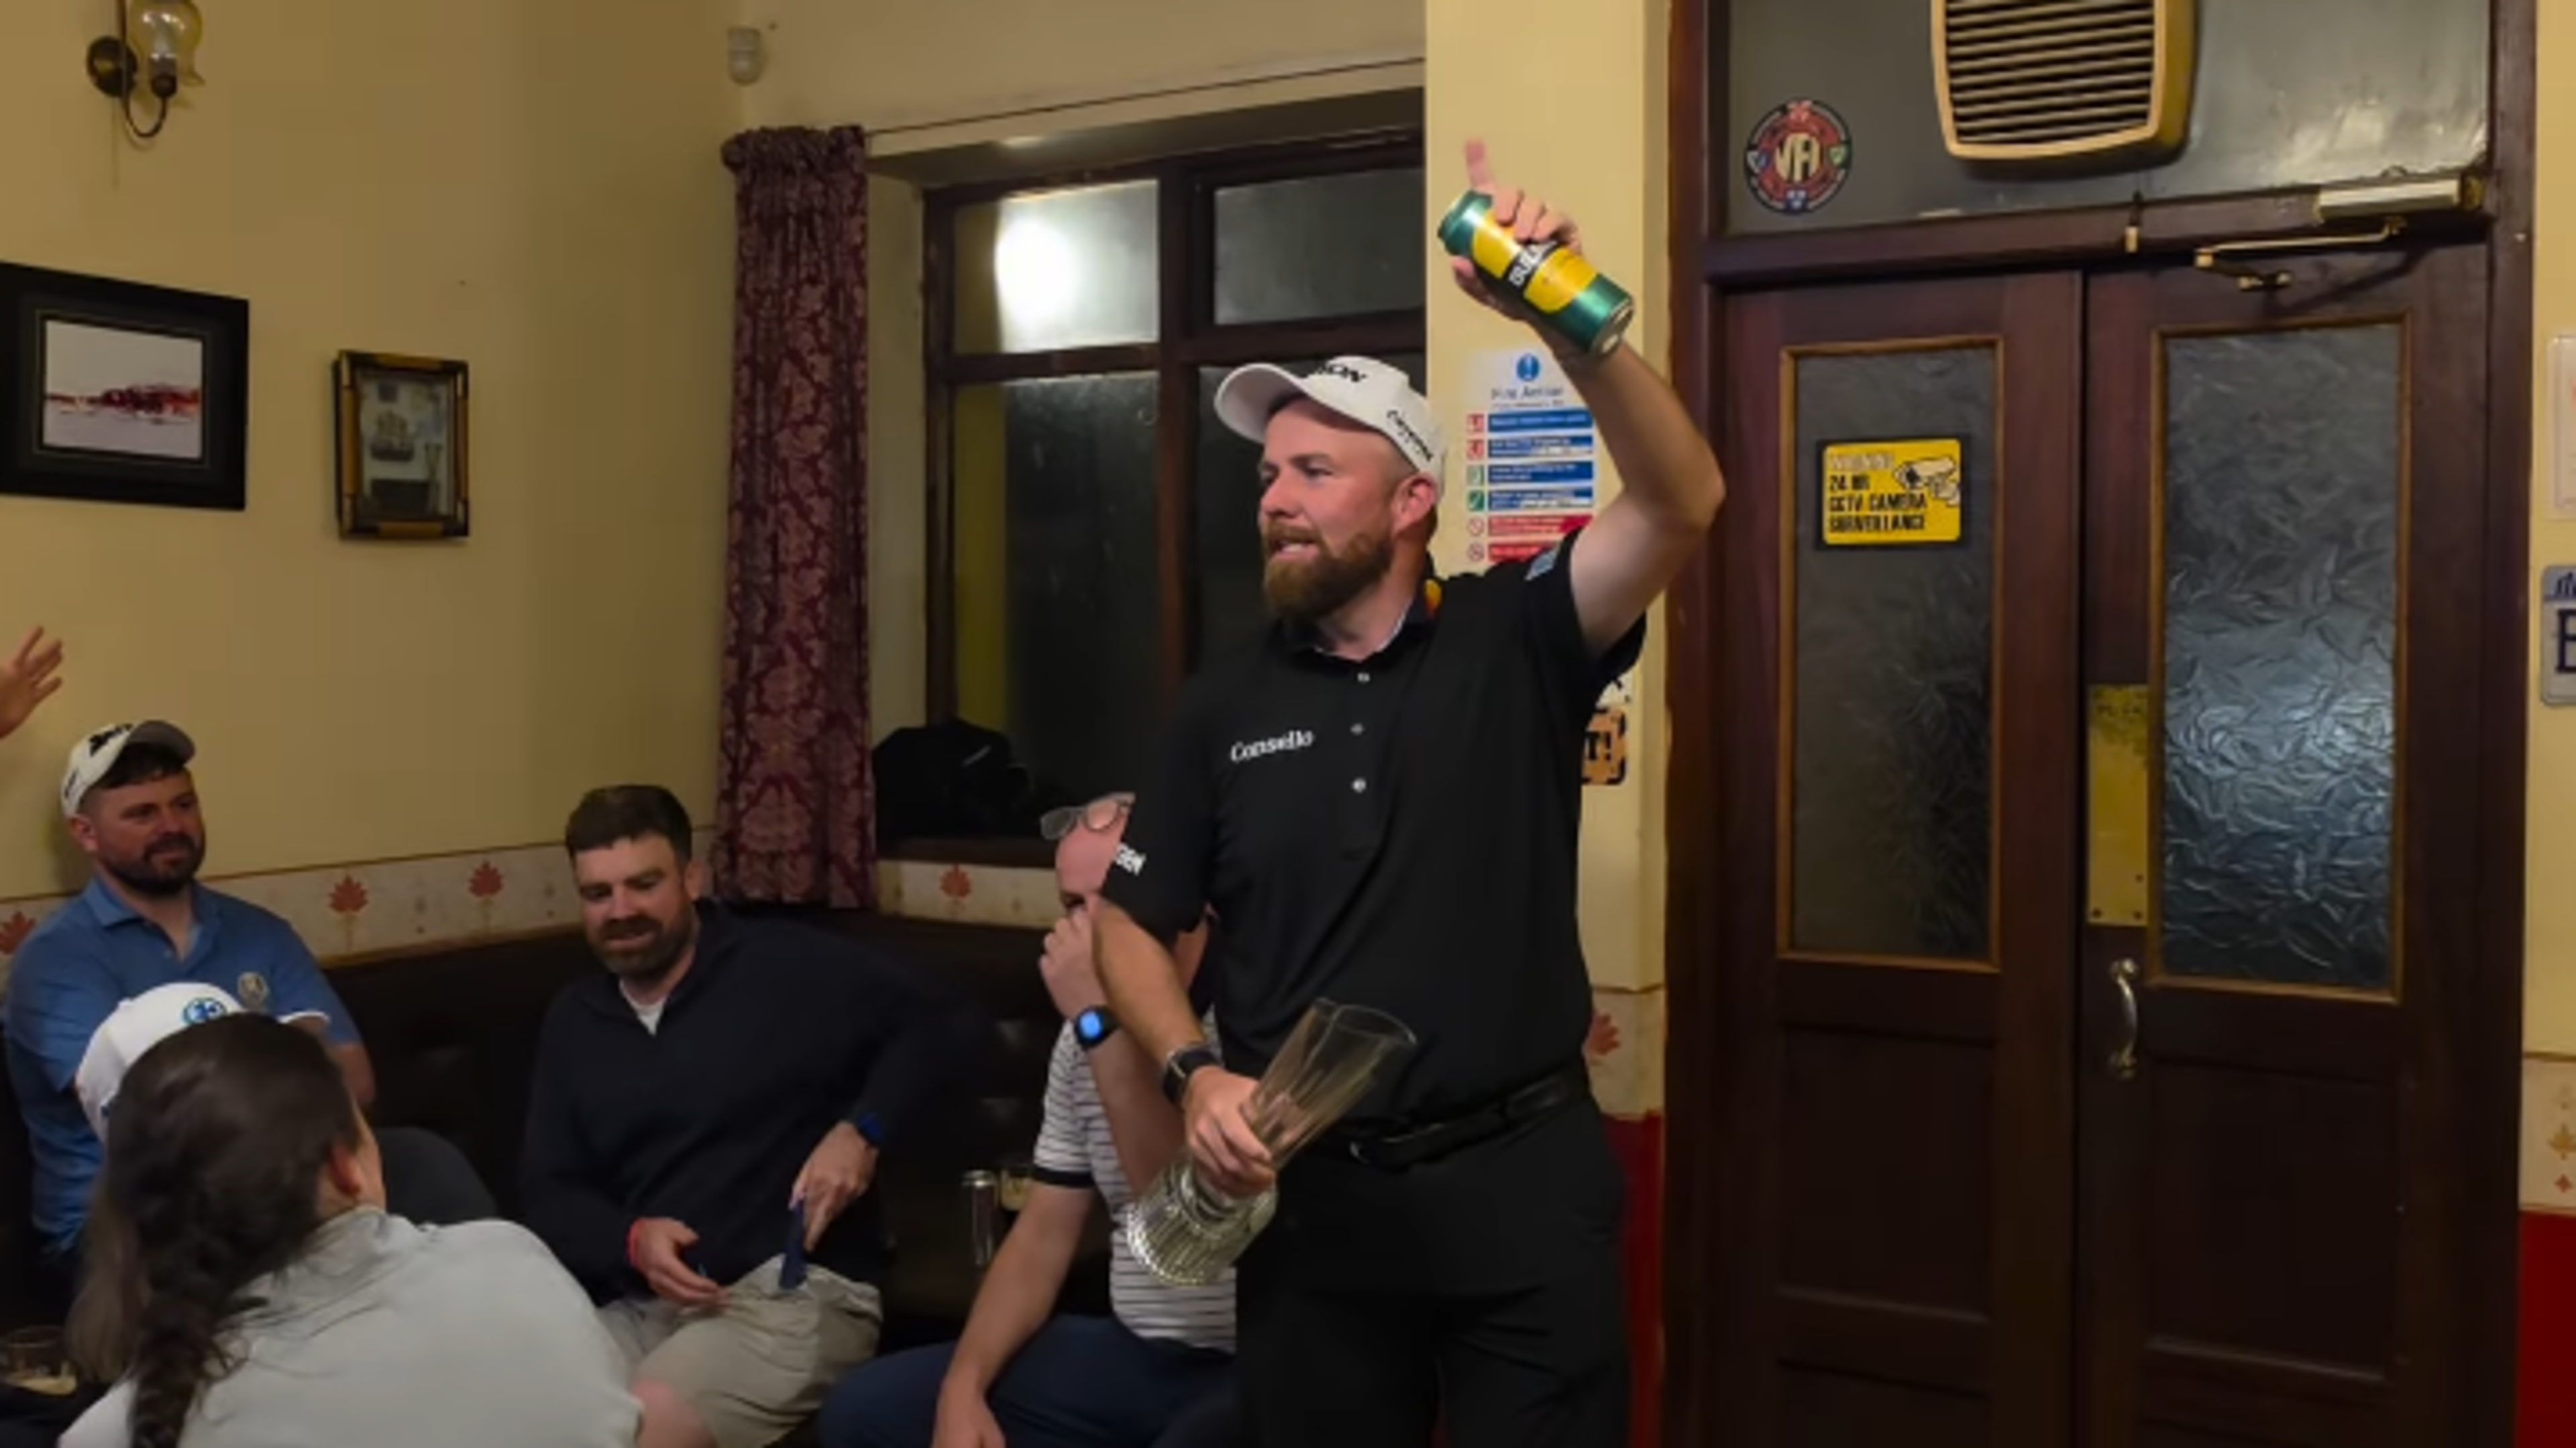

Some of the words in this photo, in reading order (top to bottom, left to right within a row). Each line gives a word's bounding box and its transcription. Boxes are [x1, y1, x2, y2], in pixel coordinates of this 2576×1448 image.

[1829, 475, 1847, 491] 24
[1829, 494, 1864, 512] CCTV
[1870, 492, 1927, 510] CAMERA
[1230, 729, 1316, 763] Consello
